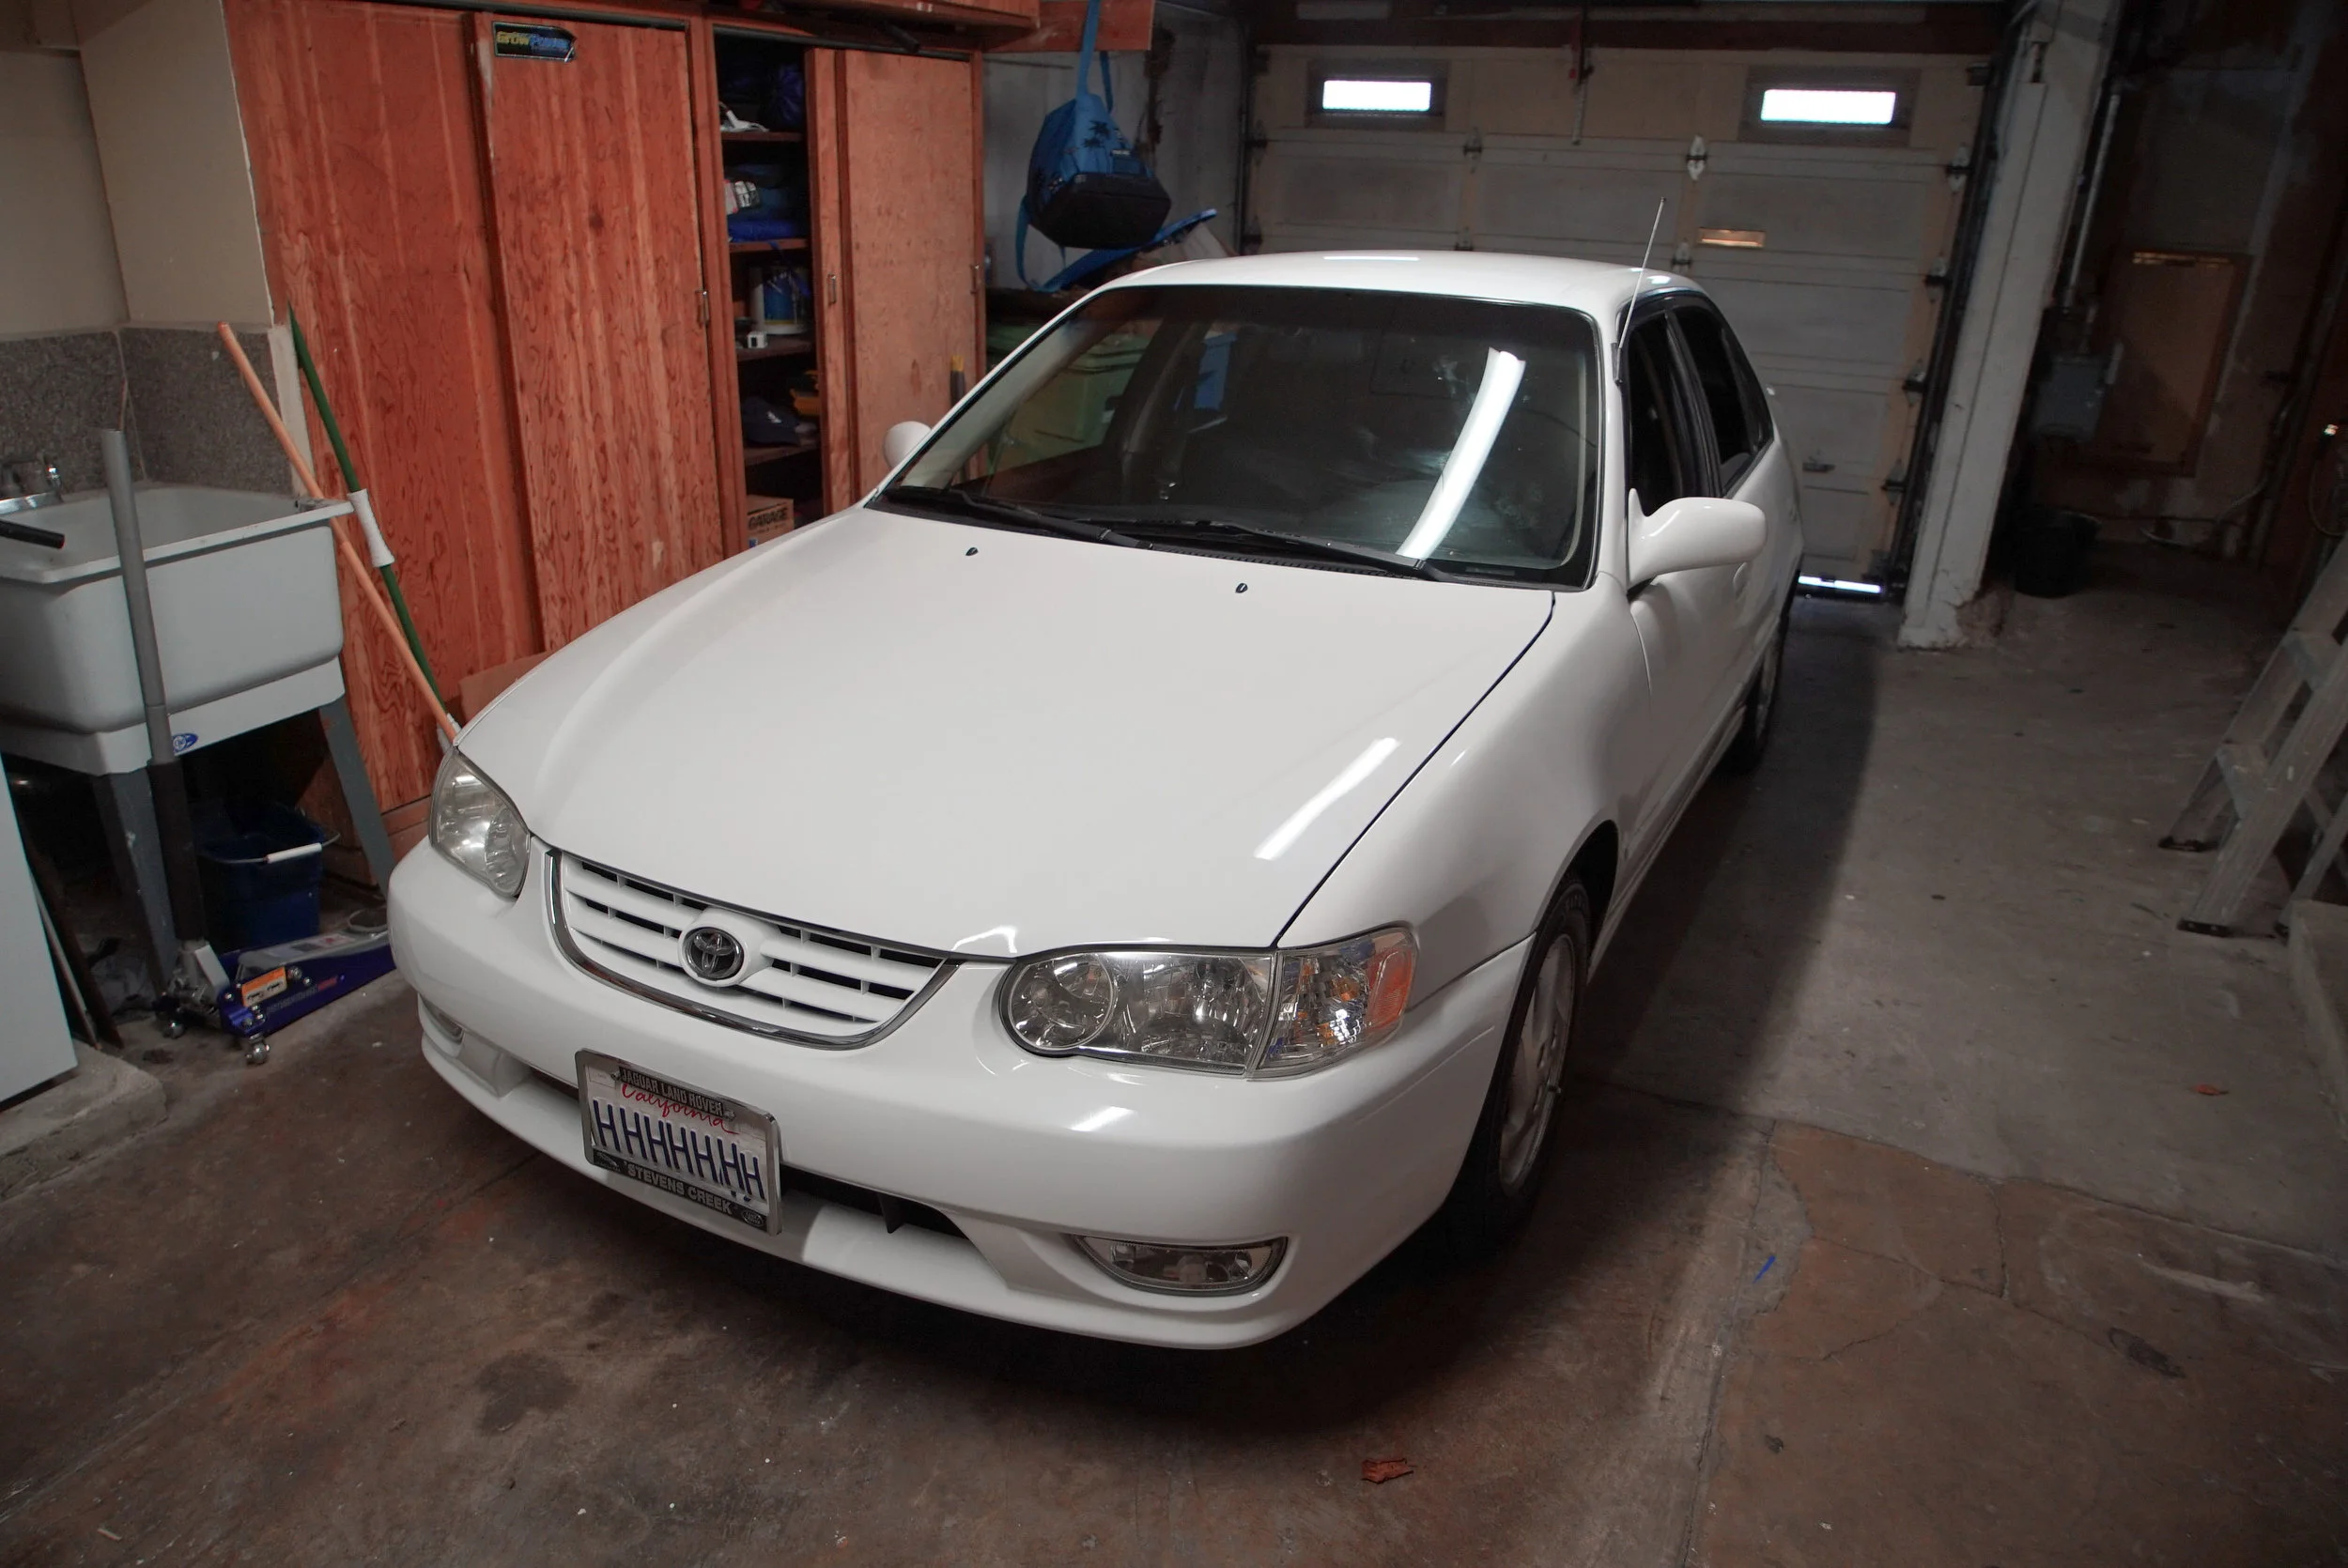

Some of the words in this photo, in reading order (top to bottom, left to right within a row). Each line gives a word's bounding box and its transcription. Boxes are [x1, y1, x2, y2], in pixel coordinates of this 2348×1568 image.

[621, 1068, 658, 1093] JAGUAR
[660, 1084, 687, 1104] LAND
[688, 1093, 724, 1115] ROVER
[621, 1083, 739, 1135] California
[627, 1163, 685, 1195] STEVENS
[687, 1186, 734, 1215] CREEK
